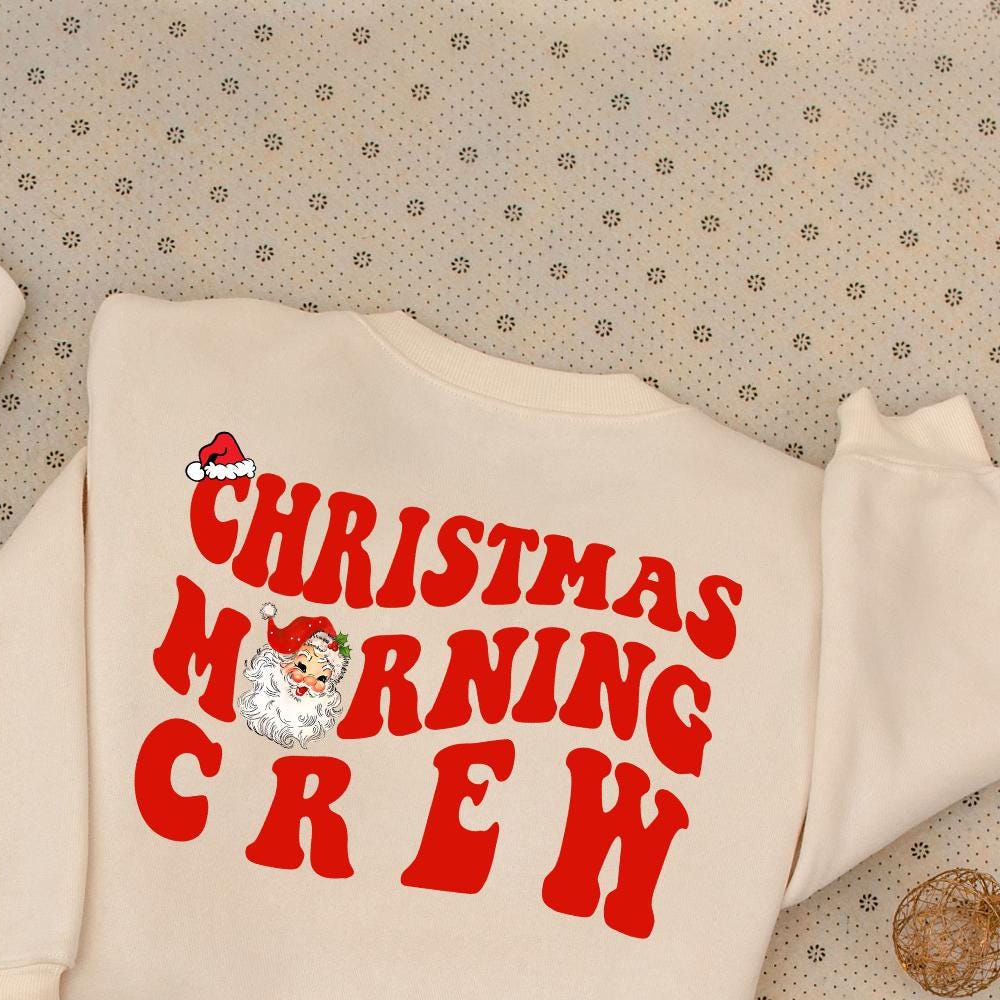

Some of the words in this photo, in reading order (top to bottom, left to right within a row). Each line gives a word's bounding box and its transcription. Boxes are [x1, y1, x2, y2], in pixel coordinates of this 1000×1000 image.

[190, 473, 743, 660] CHRISTMAS
[152, 575, 713, 778] MRNING
[134, 718, 690, 939] CREW
